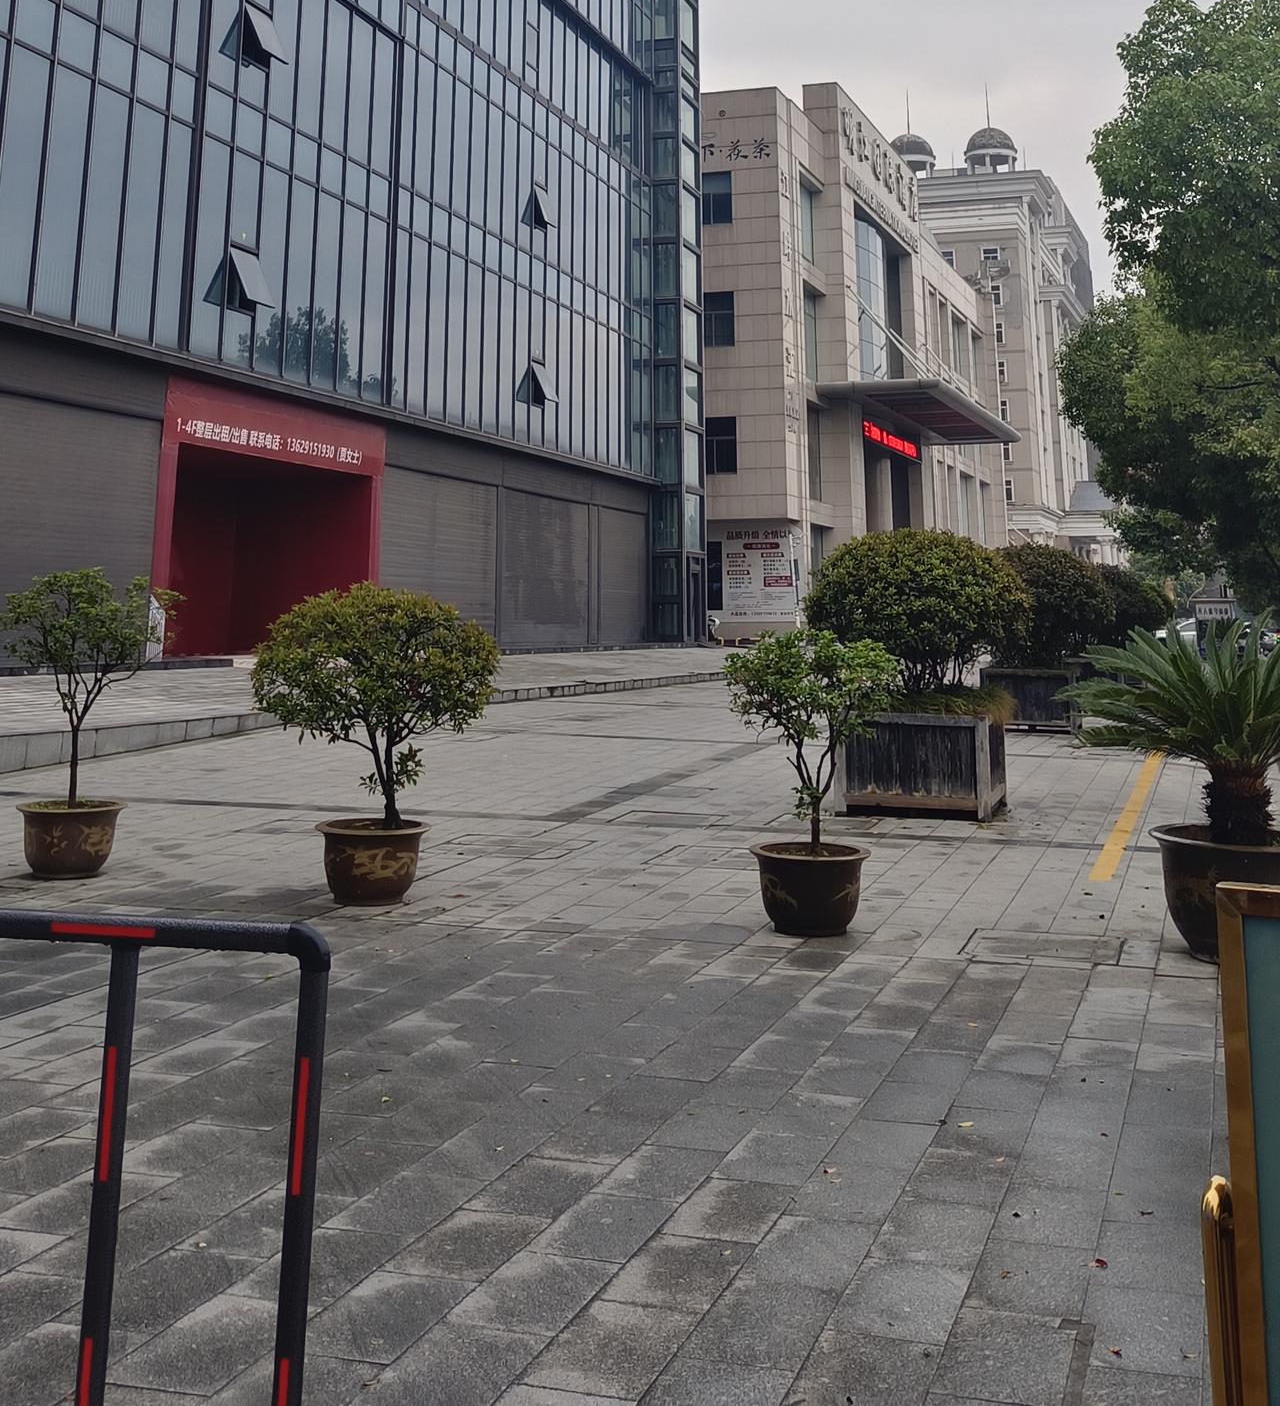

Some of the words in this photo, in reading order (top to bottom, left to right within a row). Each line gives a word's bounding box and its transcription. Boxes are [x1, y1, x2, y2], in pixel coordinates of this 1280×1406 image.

[177, 418, 249, 445] 1-4F整层出租/出售
